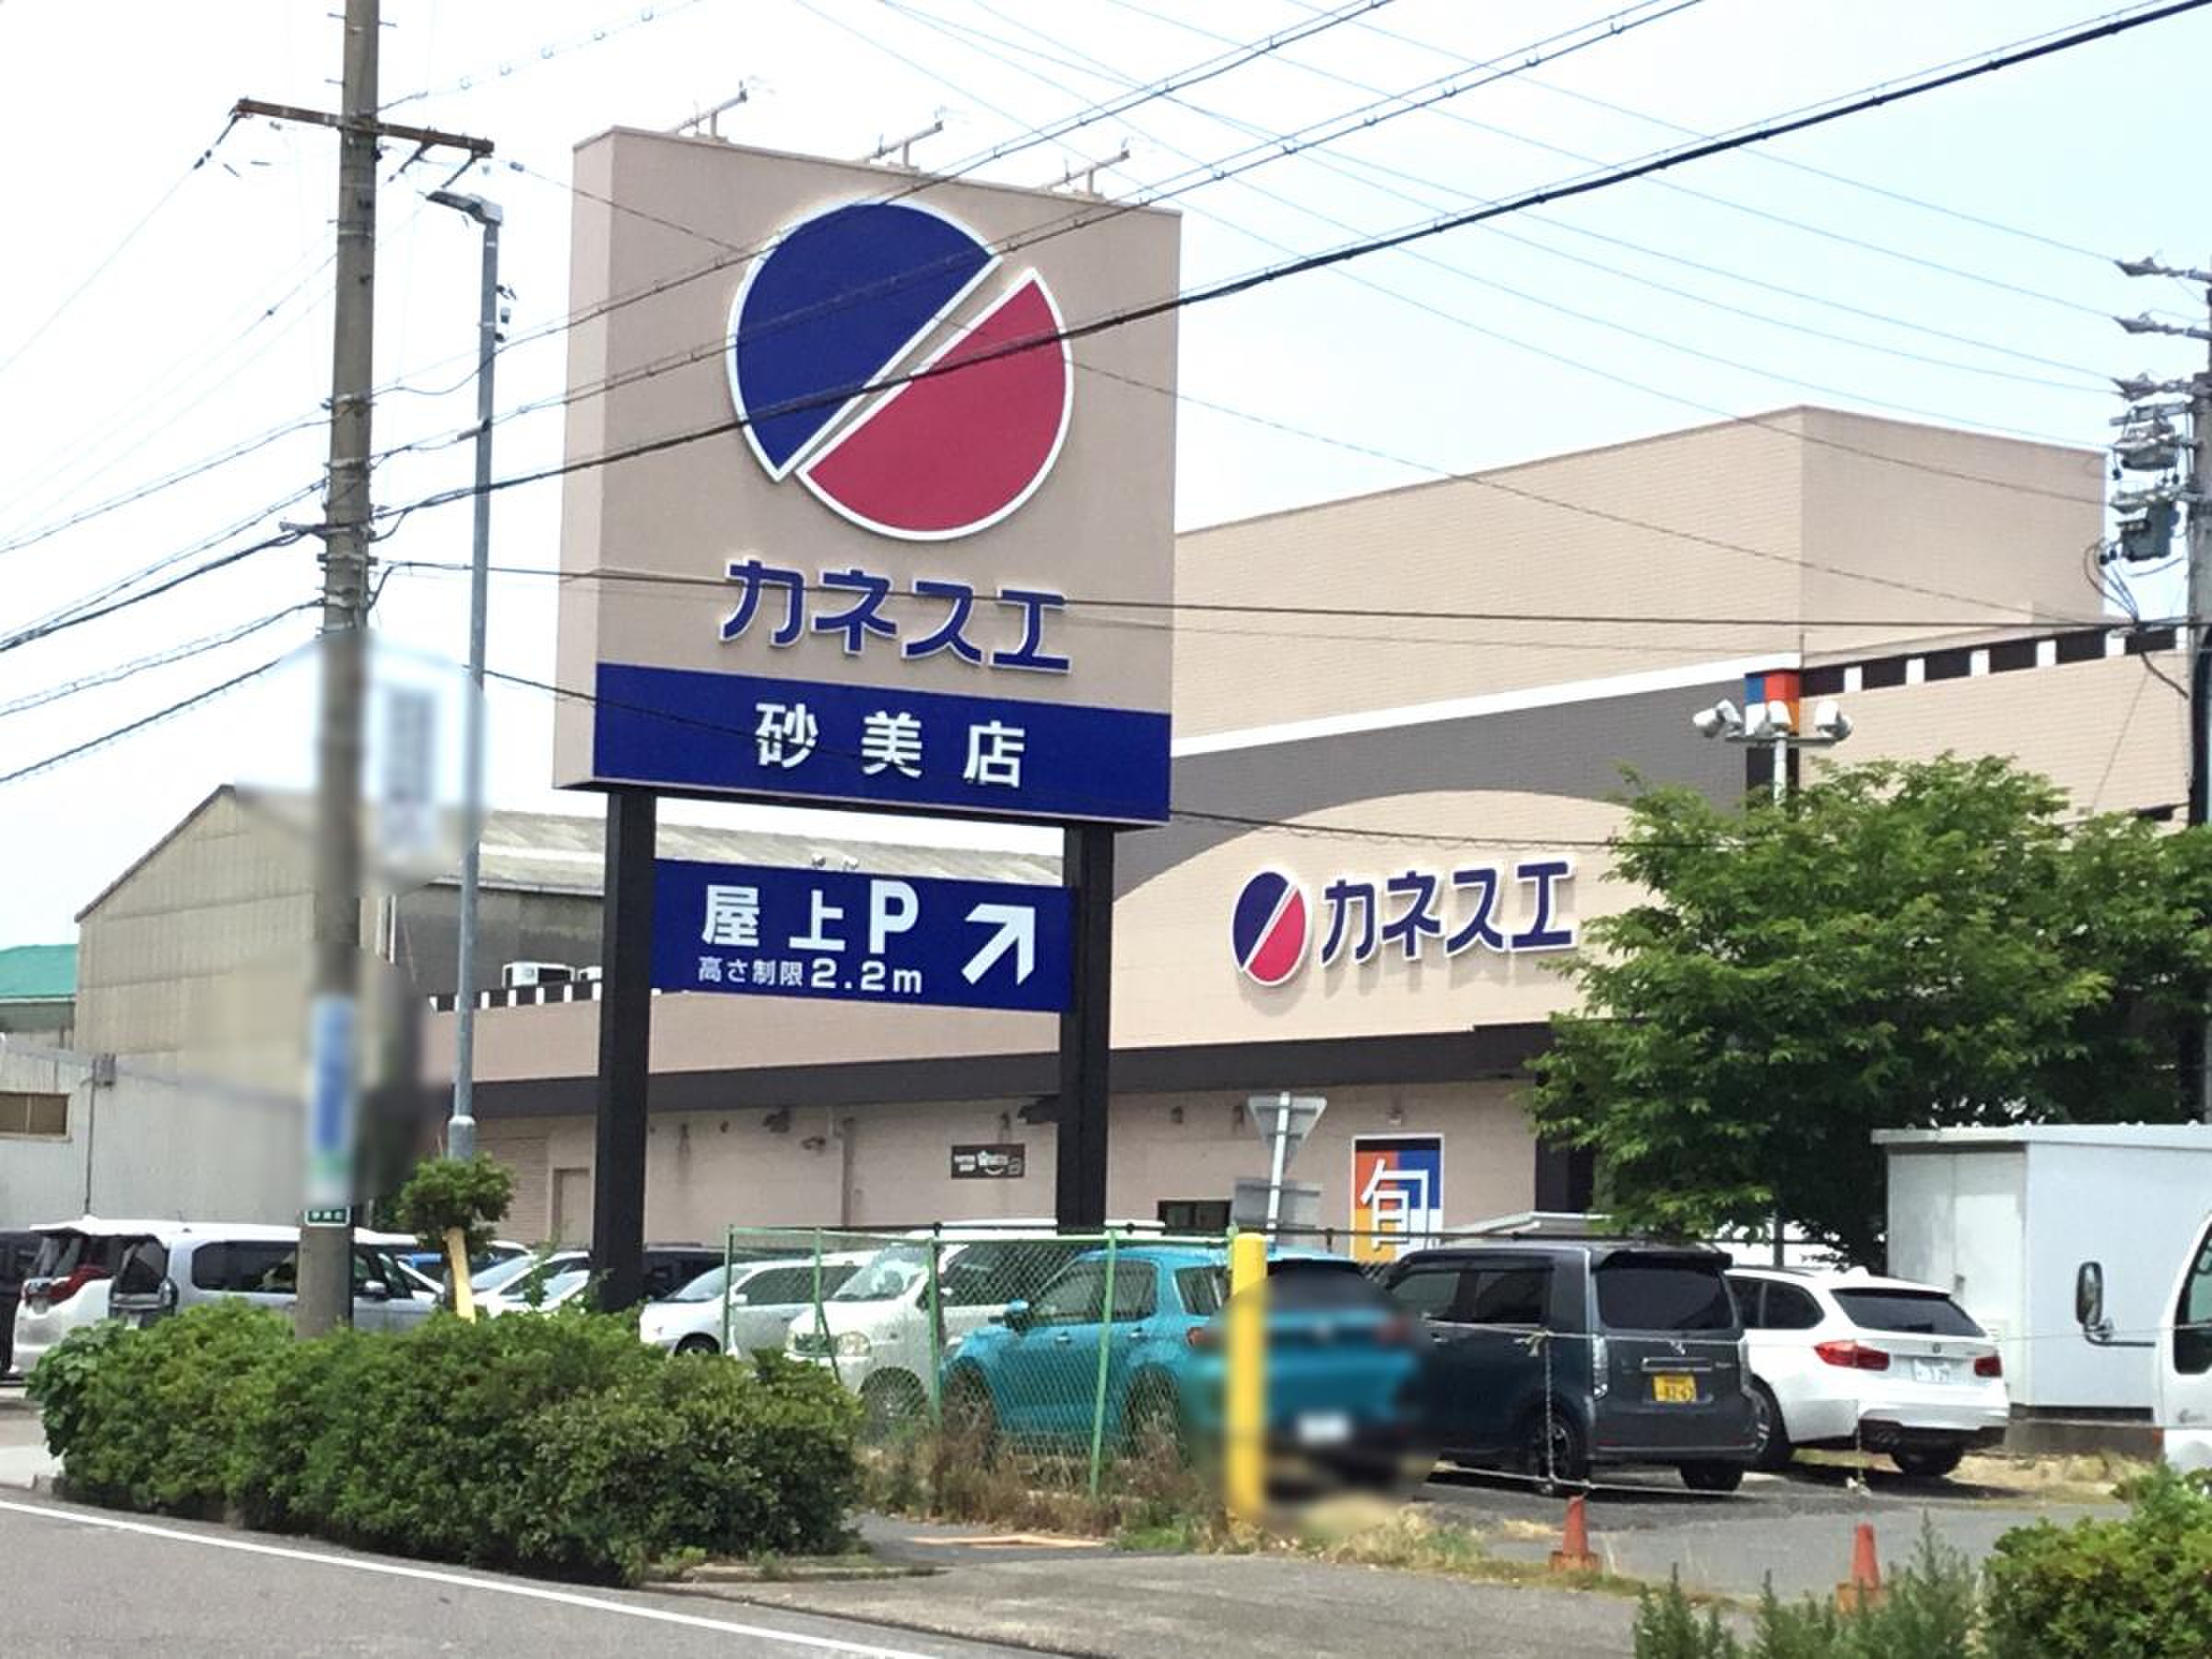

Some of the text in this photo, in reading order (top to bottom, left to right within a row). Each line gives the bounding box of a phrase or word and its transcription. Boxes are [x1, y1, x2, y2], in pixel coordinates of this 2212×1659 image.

[720, 559, 1071, 673] カネスエ
[754, 702, 1026, 788] 砂美店
[1320, 860, 1575, 965] カネスエ
[1359, 1158, 1430, 1252] 旬
